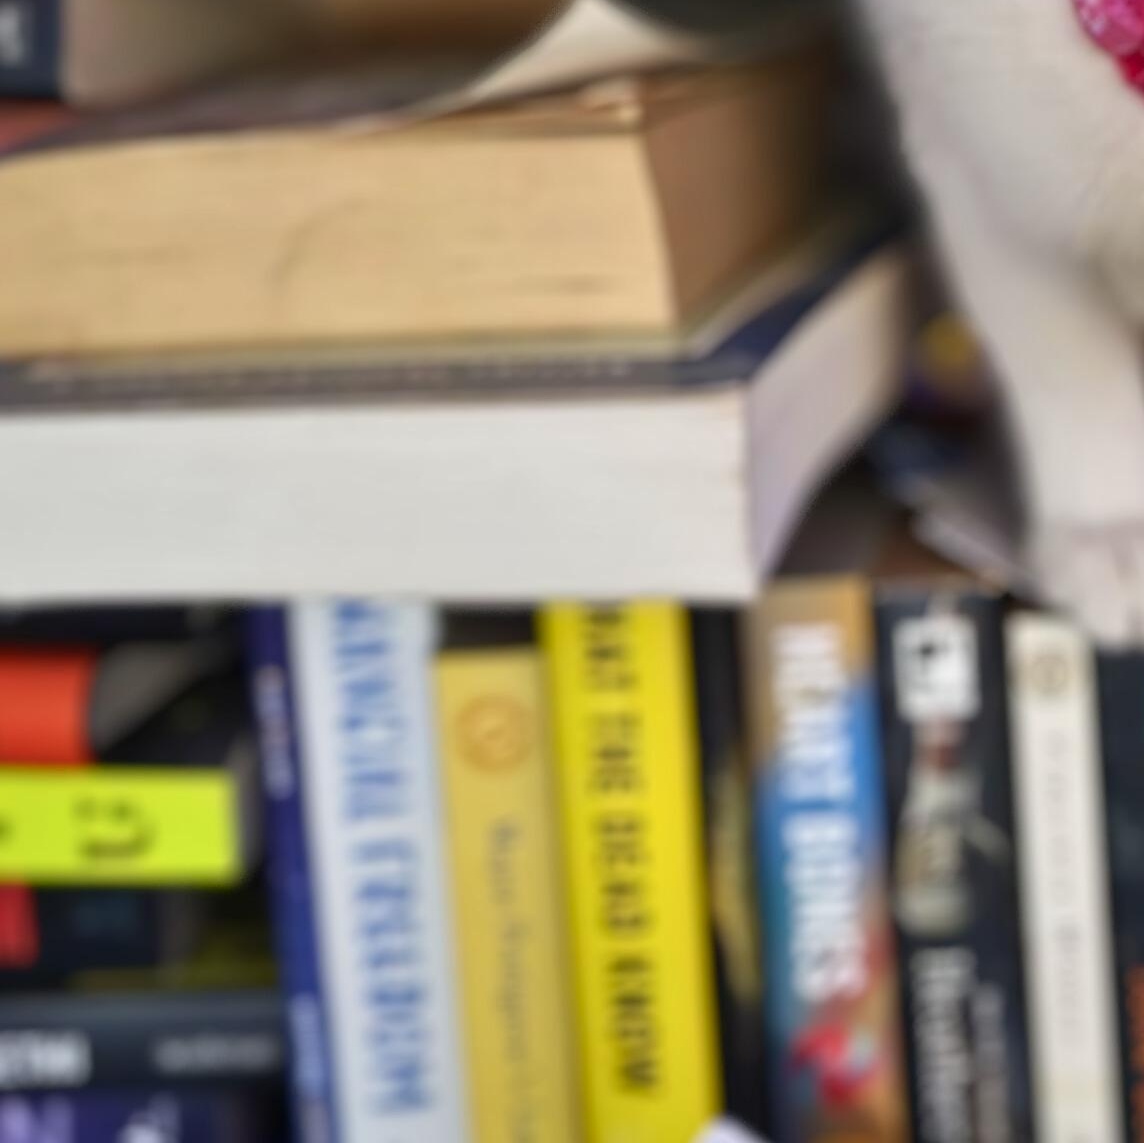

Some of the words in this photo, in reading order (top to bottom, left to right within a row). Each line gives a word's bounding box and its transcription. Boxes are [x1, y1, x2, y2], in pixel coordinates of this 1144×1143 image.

[594, 811, 652, 939] DEAD
[783, 813, 862, 1001] BONES
[604, 951, 664, 1096] KNOW
